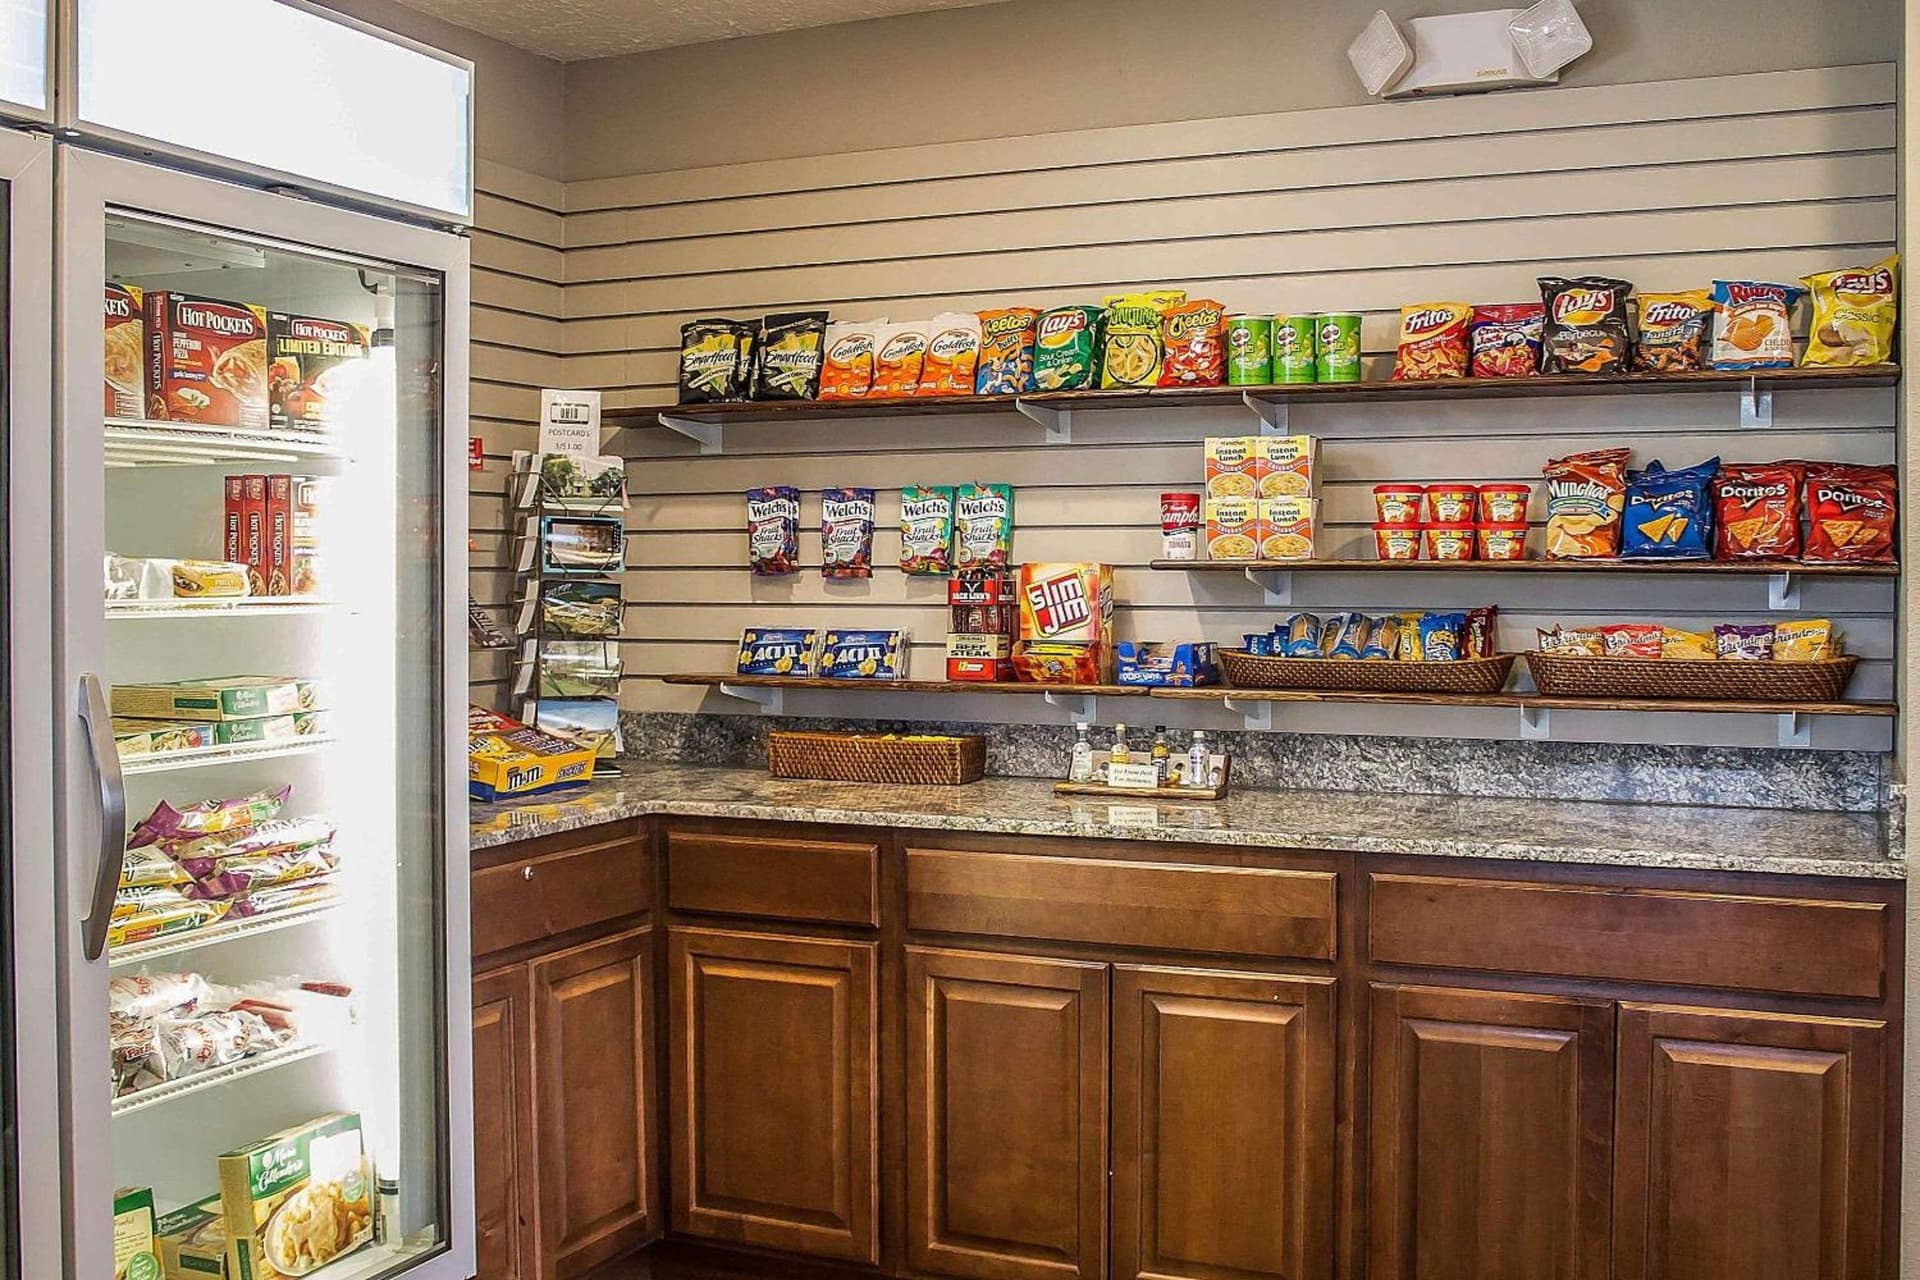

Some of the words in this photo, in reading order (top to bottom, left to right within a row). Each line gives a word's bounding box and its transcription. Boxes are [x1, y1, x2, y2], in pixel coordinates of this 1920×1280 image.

[1647, 303, 1697, 323] Fritos
[1834, 309, 1879, 323] Classic
[182, 309, 206, 326] HOT
[208, 312, 252, 335] POCKETS
[295, 323, 312, 337] HOT
[313, 326, 348, 341] POCKETS
[280, 338, 320, 354] LIMITED
[833, 341, 872, 358] Goldfish
[883, 341, 924, 359] Goldfish
[934, 338, 976, 352] Goldfish
[1267, 446, 1298, 454] Instant
[1721, 484, 1786, 498] Doritos
[1818, 490, 1885, 508] Doritos
[751, 501, 786, 518] Welch's
[827, 502, 868, 518] Welch's
[904, 502, 948, 516] Welch's
[961, 501, 1004, 515] Welch's
[1269, 508, 1300, 516] Instant
